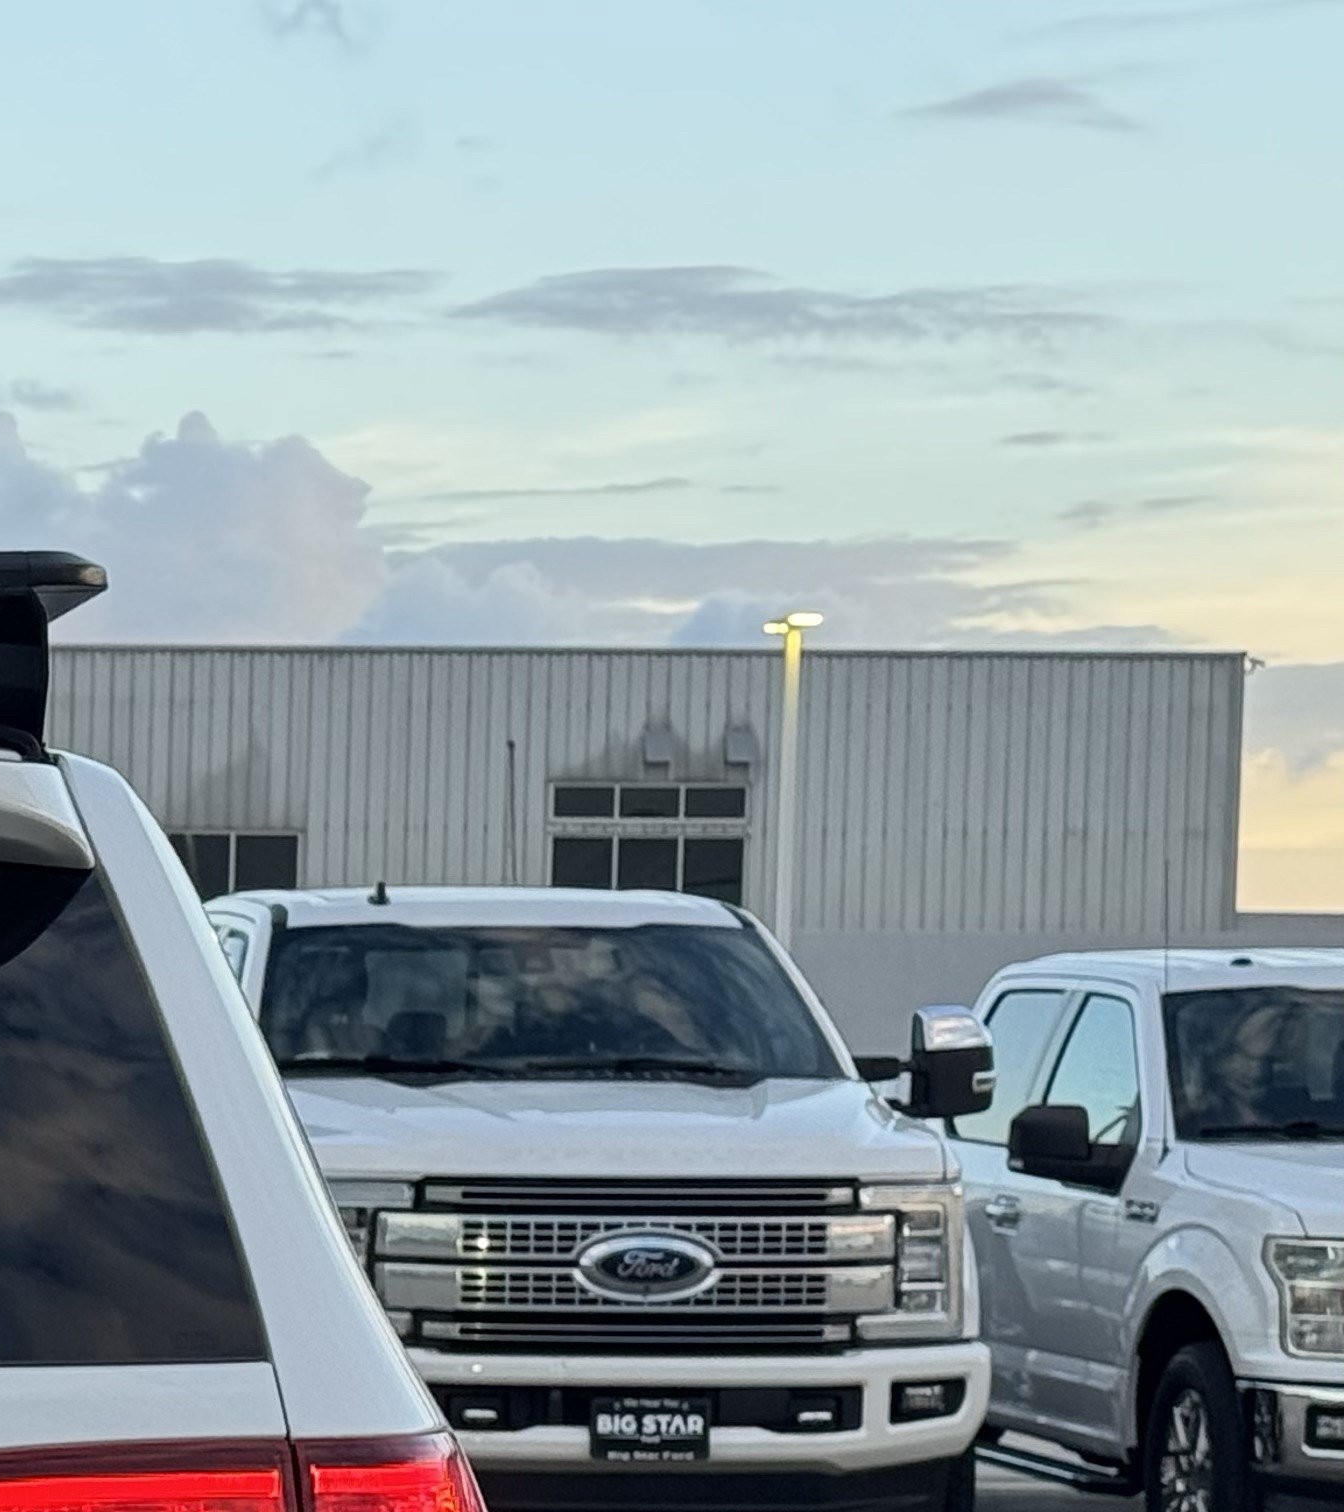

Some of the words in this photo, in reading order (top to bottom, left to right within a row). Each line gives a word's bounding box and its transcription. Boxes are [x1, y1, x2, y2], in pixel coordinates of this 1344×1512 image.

[617, 1249, 680, 1278] Ford
[596, 1413, 638, 1435] BIG
[642, 1413, 704, 1435] STAR
